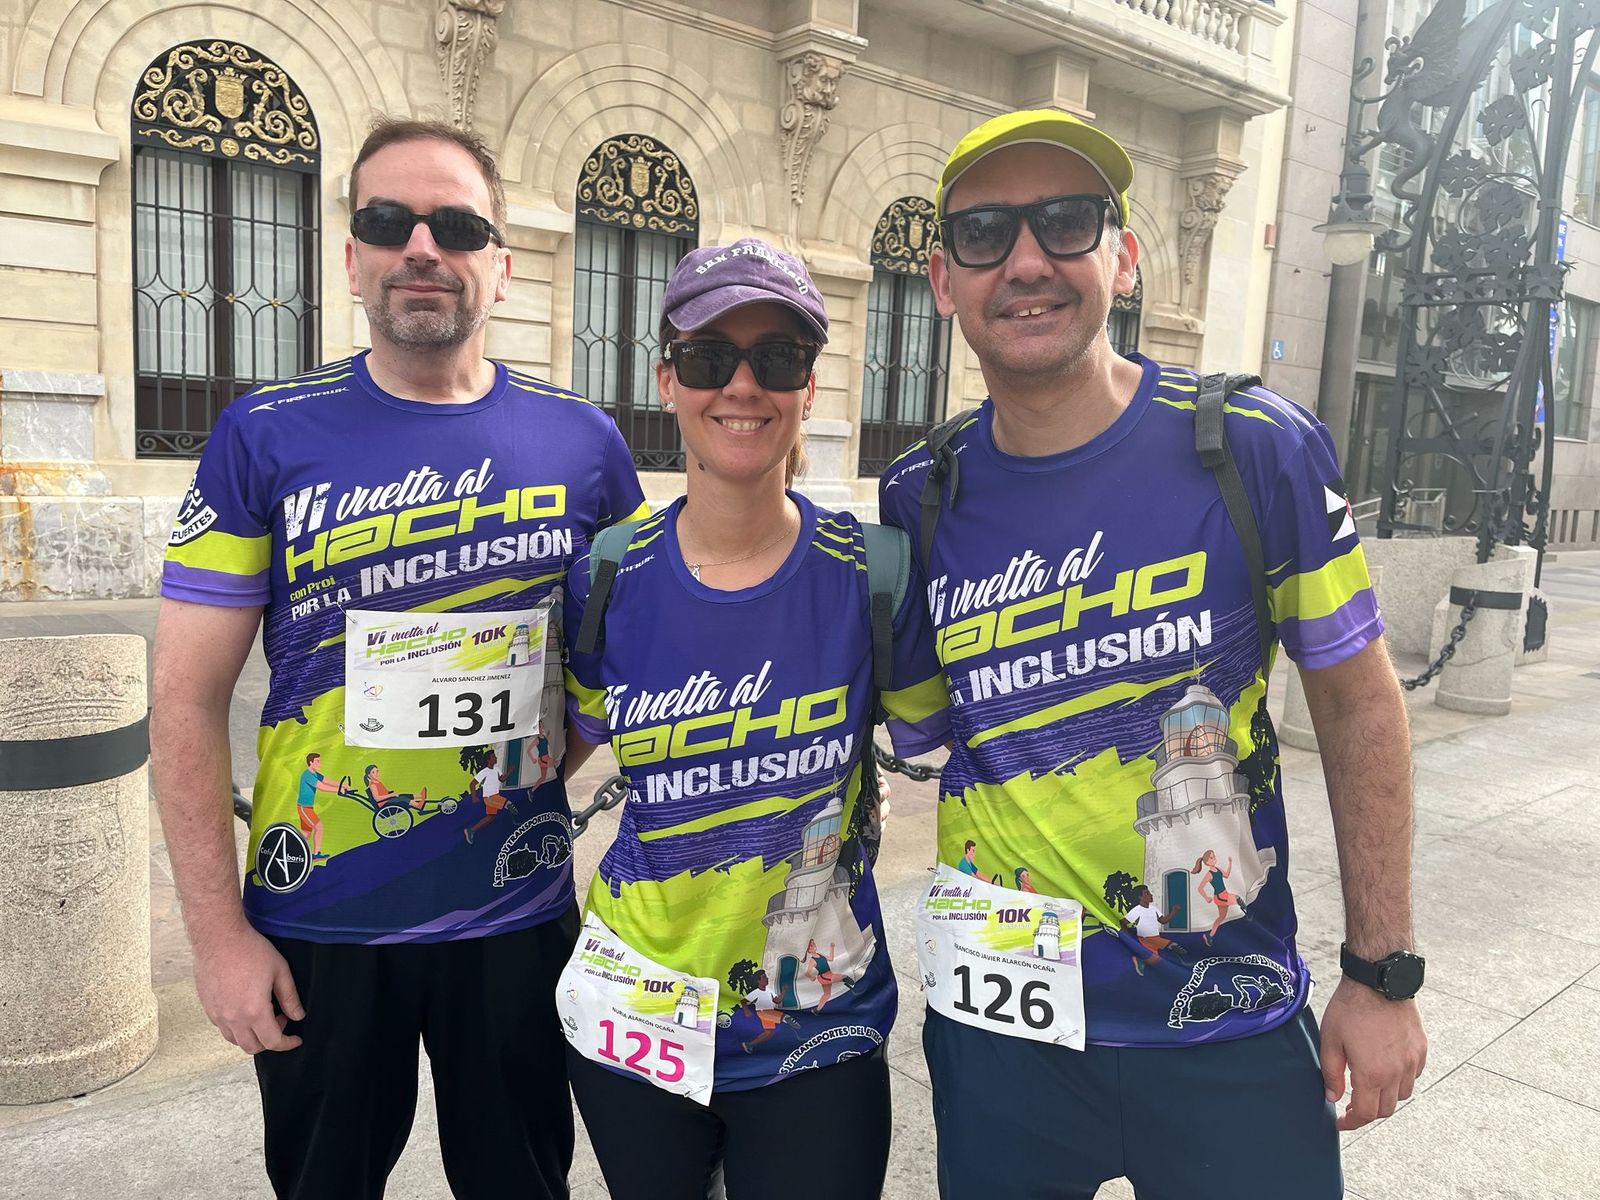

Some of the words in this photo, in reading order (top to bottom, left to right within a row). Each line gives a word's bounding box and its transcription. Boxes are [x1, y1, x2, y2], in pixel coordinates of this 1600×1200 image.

[695, 253, 728, 274] SAN
[731, 245, 809, 295] FRANCISCO
[335, 465, 450, 521] vuelta
[453, 458, 494, 498] al
[171, 511, 212, 539] FUERTES
[290, 587, 307, 602] con
[307, 576, 336, 594] Proi
[291, 597, 320, 621] POR
[323, 587, 352, 608] LA
[360, 523, 573, 597] INCLUSIÓN
[950, 550, 1053, 619] vuelta
[1057, 530, 1104, 587] al
[380, 658, 395, 667] POR
[408, 640, 461, 660] INCLUSIÓN
[391, 626, 425, 642] vuelta
[426, 622, 439, 635] al
[472, 625, 507, 646] 10K
[969, 609, 1212, 702] INCLUSIÓN
[418, 689, 516, 738] 131
[624, 670, 728, 727] vuelta
[729, 660, 772, 708] al
[646, 733, 853, 804] INCLUSIÓN
[493, 852, 507, 887] ARIDOS
[506, 812, 551, 847] TRANSPORTES
[948, 911, 987, 921] INCLUSIÓN
[996, 908, 1032, 924] 10K
[642, 979, 676, 993] 10K
[981, 953, 1001, 962] JAVIER
[1002, 957, 1031, 968] ALARCÓN
[1033, 963, 1056, 973] OCAÑA
[953, 965, 1054, 1030] 126
[1168, 992, 1189, 1028] ARIDOS
[1181, 984, 1194, 994] Y
[598, 1019, 685, 1083] 125
[783, 1058, 793, 1069] Y
[791, 1026, 849, 1063] TRANSPORTES
[849, 1026, 865, 1036] DEL
